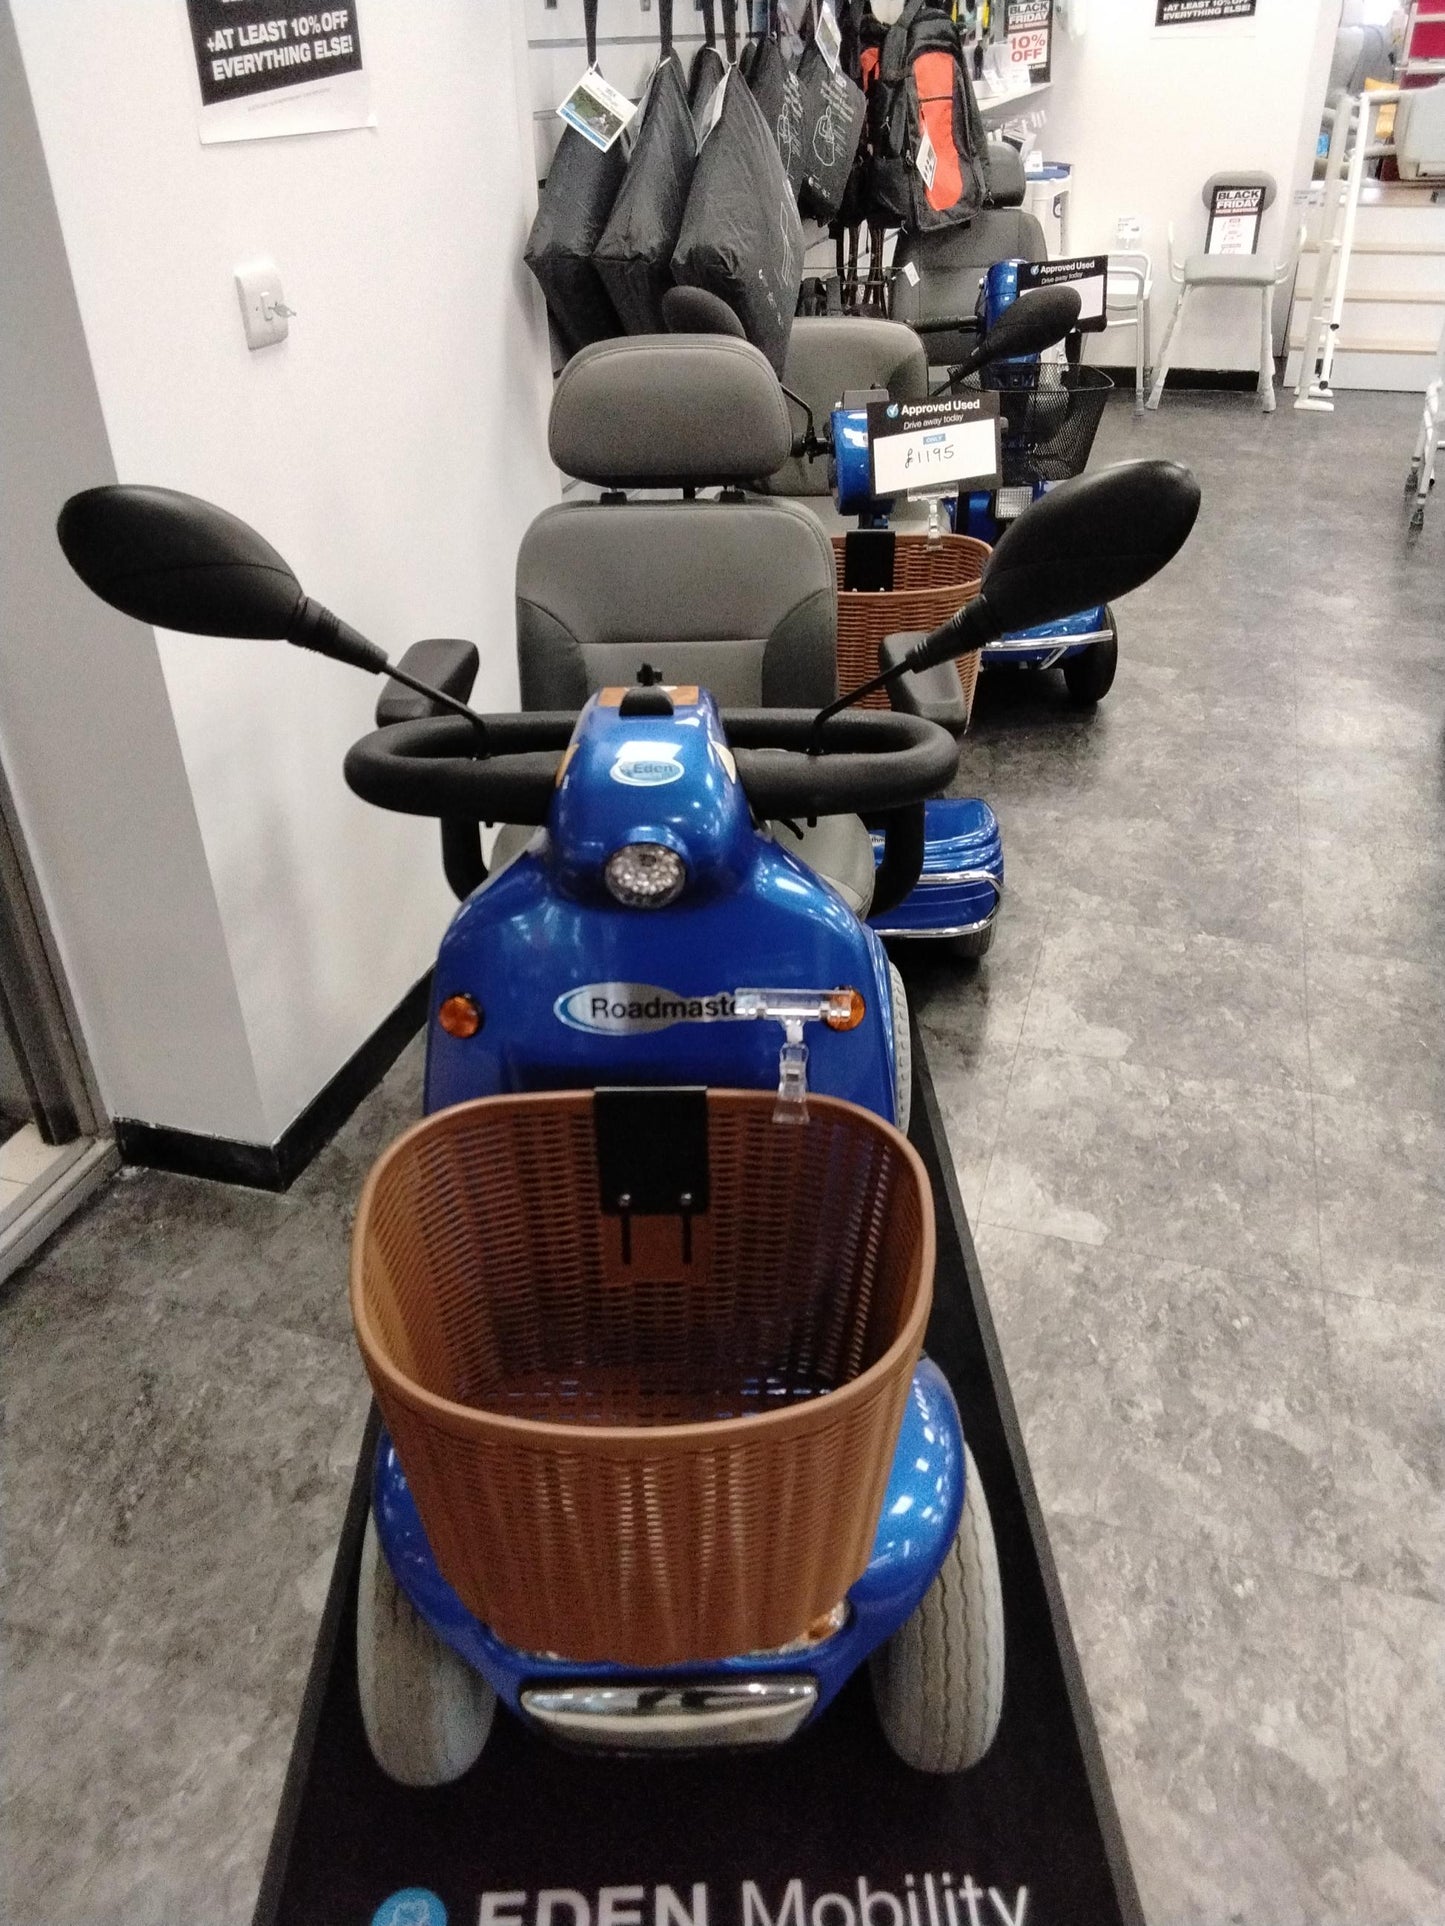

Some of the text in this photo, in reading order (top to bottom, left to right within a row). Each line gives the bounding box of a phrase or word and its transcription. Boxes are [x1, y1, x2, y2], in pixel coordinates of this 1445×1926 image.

[1010, 2, 1047, 14] BLACK
[1163, 3, 1251, 20] EVERYTHING ELSE!
[1181, 0, 1211, 10] LEAST
[1009, 12, 1049, 25] FRIDAY
[239, 20, 288, 47] LEAST
[291, 15, 321, 37] 10%
[322, 10, 348, 30] OFF
[1012, 33, 1046, 50] 10%
[212, 34, 353, 81] EVERYTHING ELSE!
[1011, 47, 1042, 62] OFF
[1218, 191, 1259, 200] BLACK
[1216, 199, 1259, 209] FRIDAY
[1041, 260, 1095, 275] Approved Used
[901, 398, 980, 417] Approved Used
[903, 413, 964, 430] Drive away today
[904, 444, 955, 469] £1195
[633, 763, 673, 774] Eden
[742, 1873, 1028, 1926] Mobility
